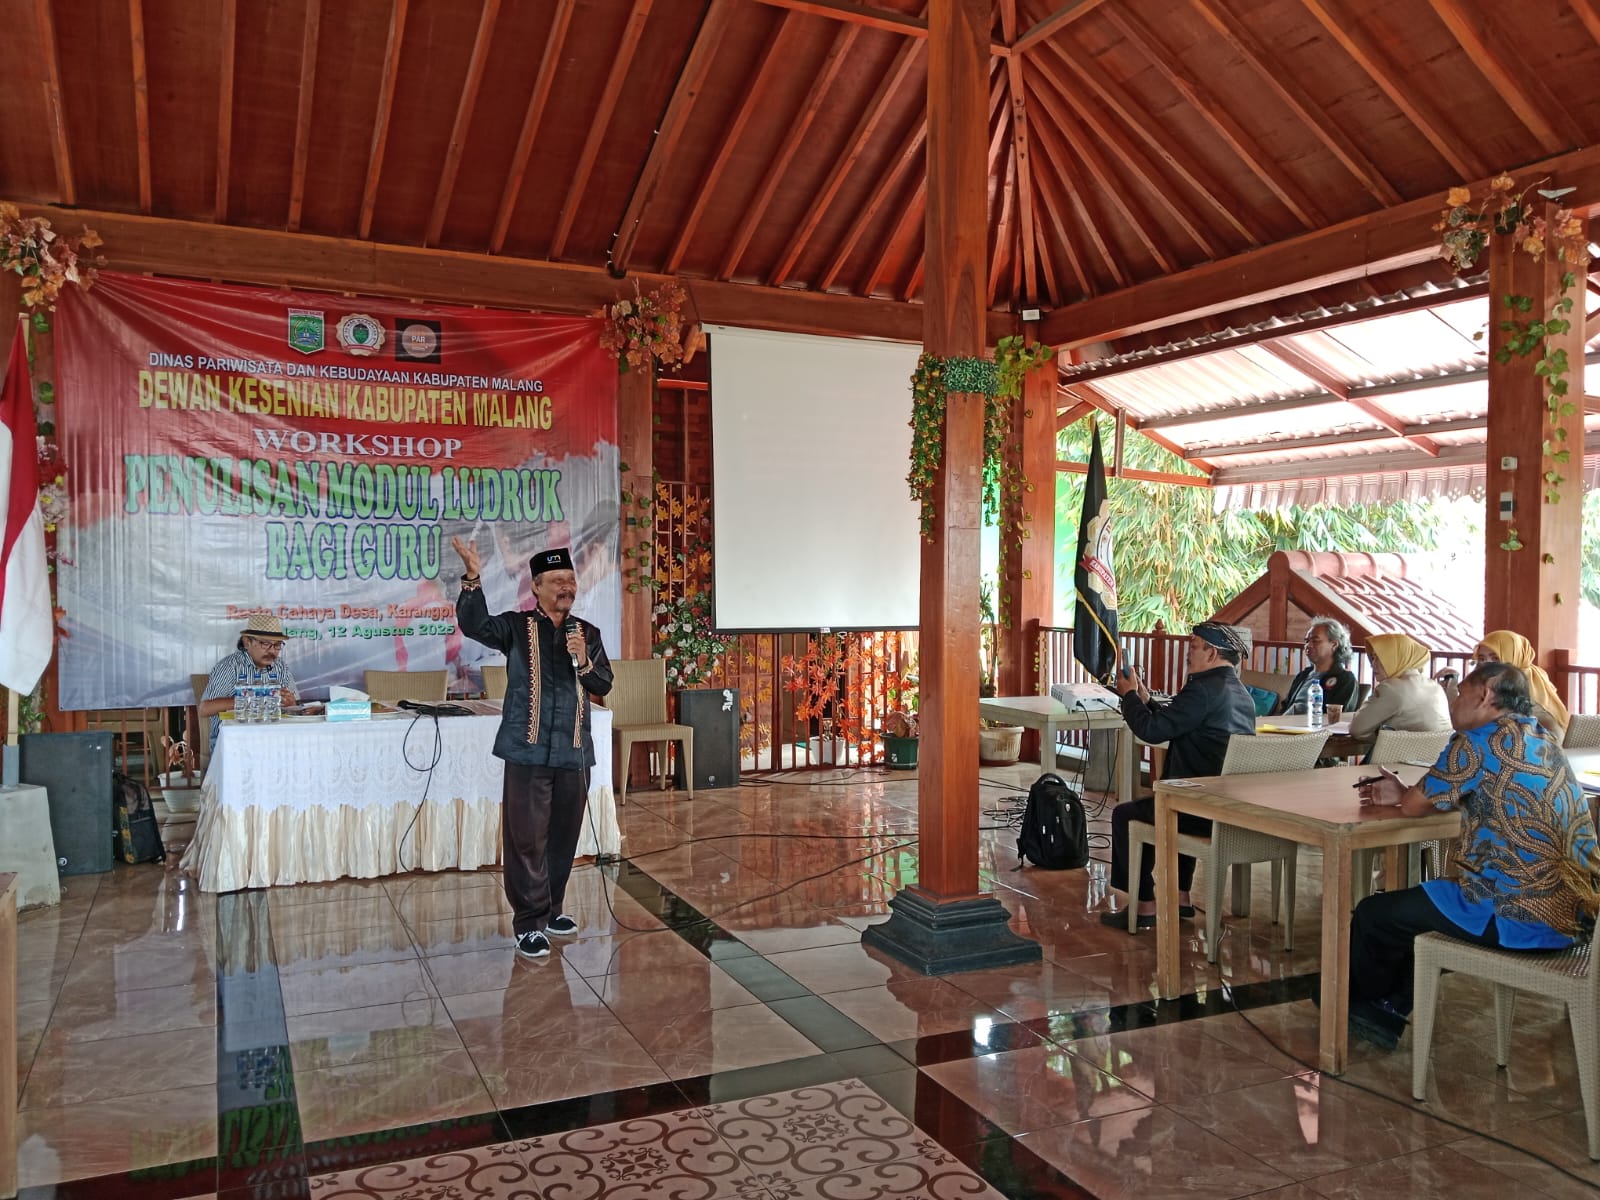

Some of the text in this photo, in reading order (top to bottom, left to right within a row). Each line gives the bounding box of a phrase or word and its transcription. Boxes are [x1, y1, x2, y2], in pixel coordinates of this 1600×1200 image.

[149, 352, 544, 393] DINAS PARIWISATA DAN KEBUDAYAAN KABUPATEN MALANG
[138, 370, 552, 431] DEWAN KESENIAN KABUPATEN MALANG
[253, 428, 463, 459] WORKSHOP
[123, 454, 565, 522] PENULISAN MODUL LUDRUK
[265, 521, 443, 581] BAGI GURU
[277, 603, 336, 623] Cahaya
[340, 603, 383, 621] Desa,
[387, 603, 456, 621] Karangpl
[282, 623, 456, 640] lang, 12 Agustus 2025
